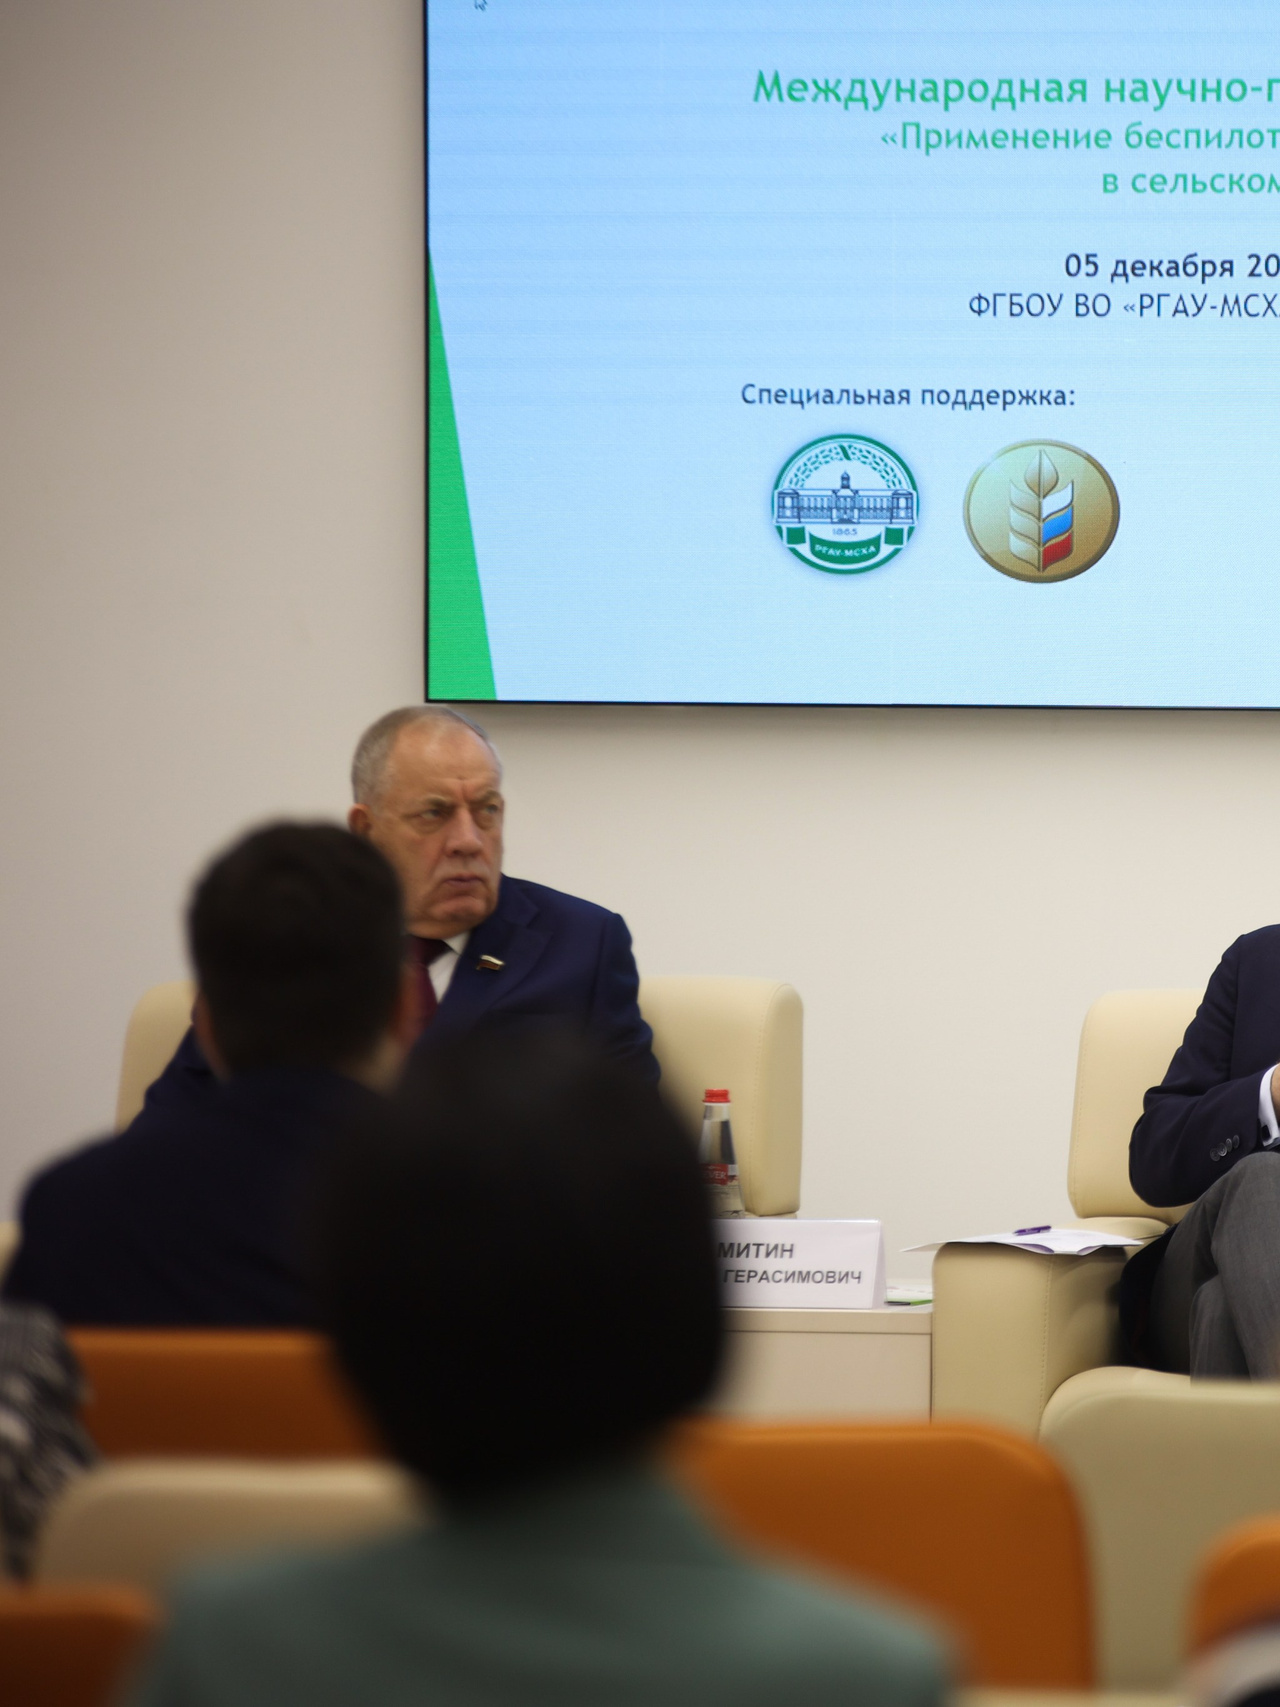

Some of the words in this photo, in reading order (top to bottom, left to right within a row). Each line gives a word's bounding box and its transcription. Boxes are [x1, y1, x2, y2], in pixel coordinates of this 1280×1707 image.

[752, 68, 1088, 112] Международная
[880, 121, 1113, 156] «Применение
[1102, 172, 1120, 195] в
[1064, 252, 1100, 278] 05
[1109, 252, 1235, 285] декабря
[968, 292, 1064, 318] ФГБОУ
[1074, 292, 1112, 318] ВО
[741, 384, 911, 410] Специальная
[920, 388, 1075, 411] поддержка:
[815, 544, 876, 556] РГАУ-МСХА
[717, 1242, 794, 1259] МИТИН
[724, 1269, 862, 1285] ГЕРАСИМОВИЧ
